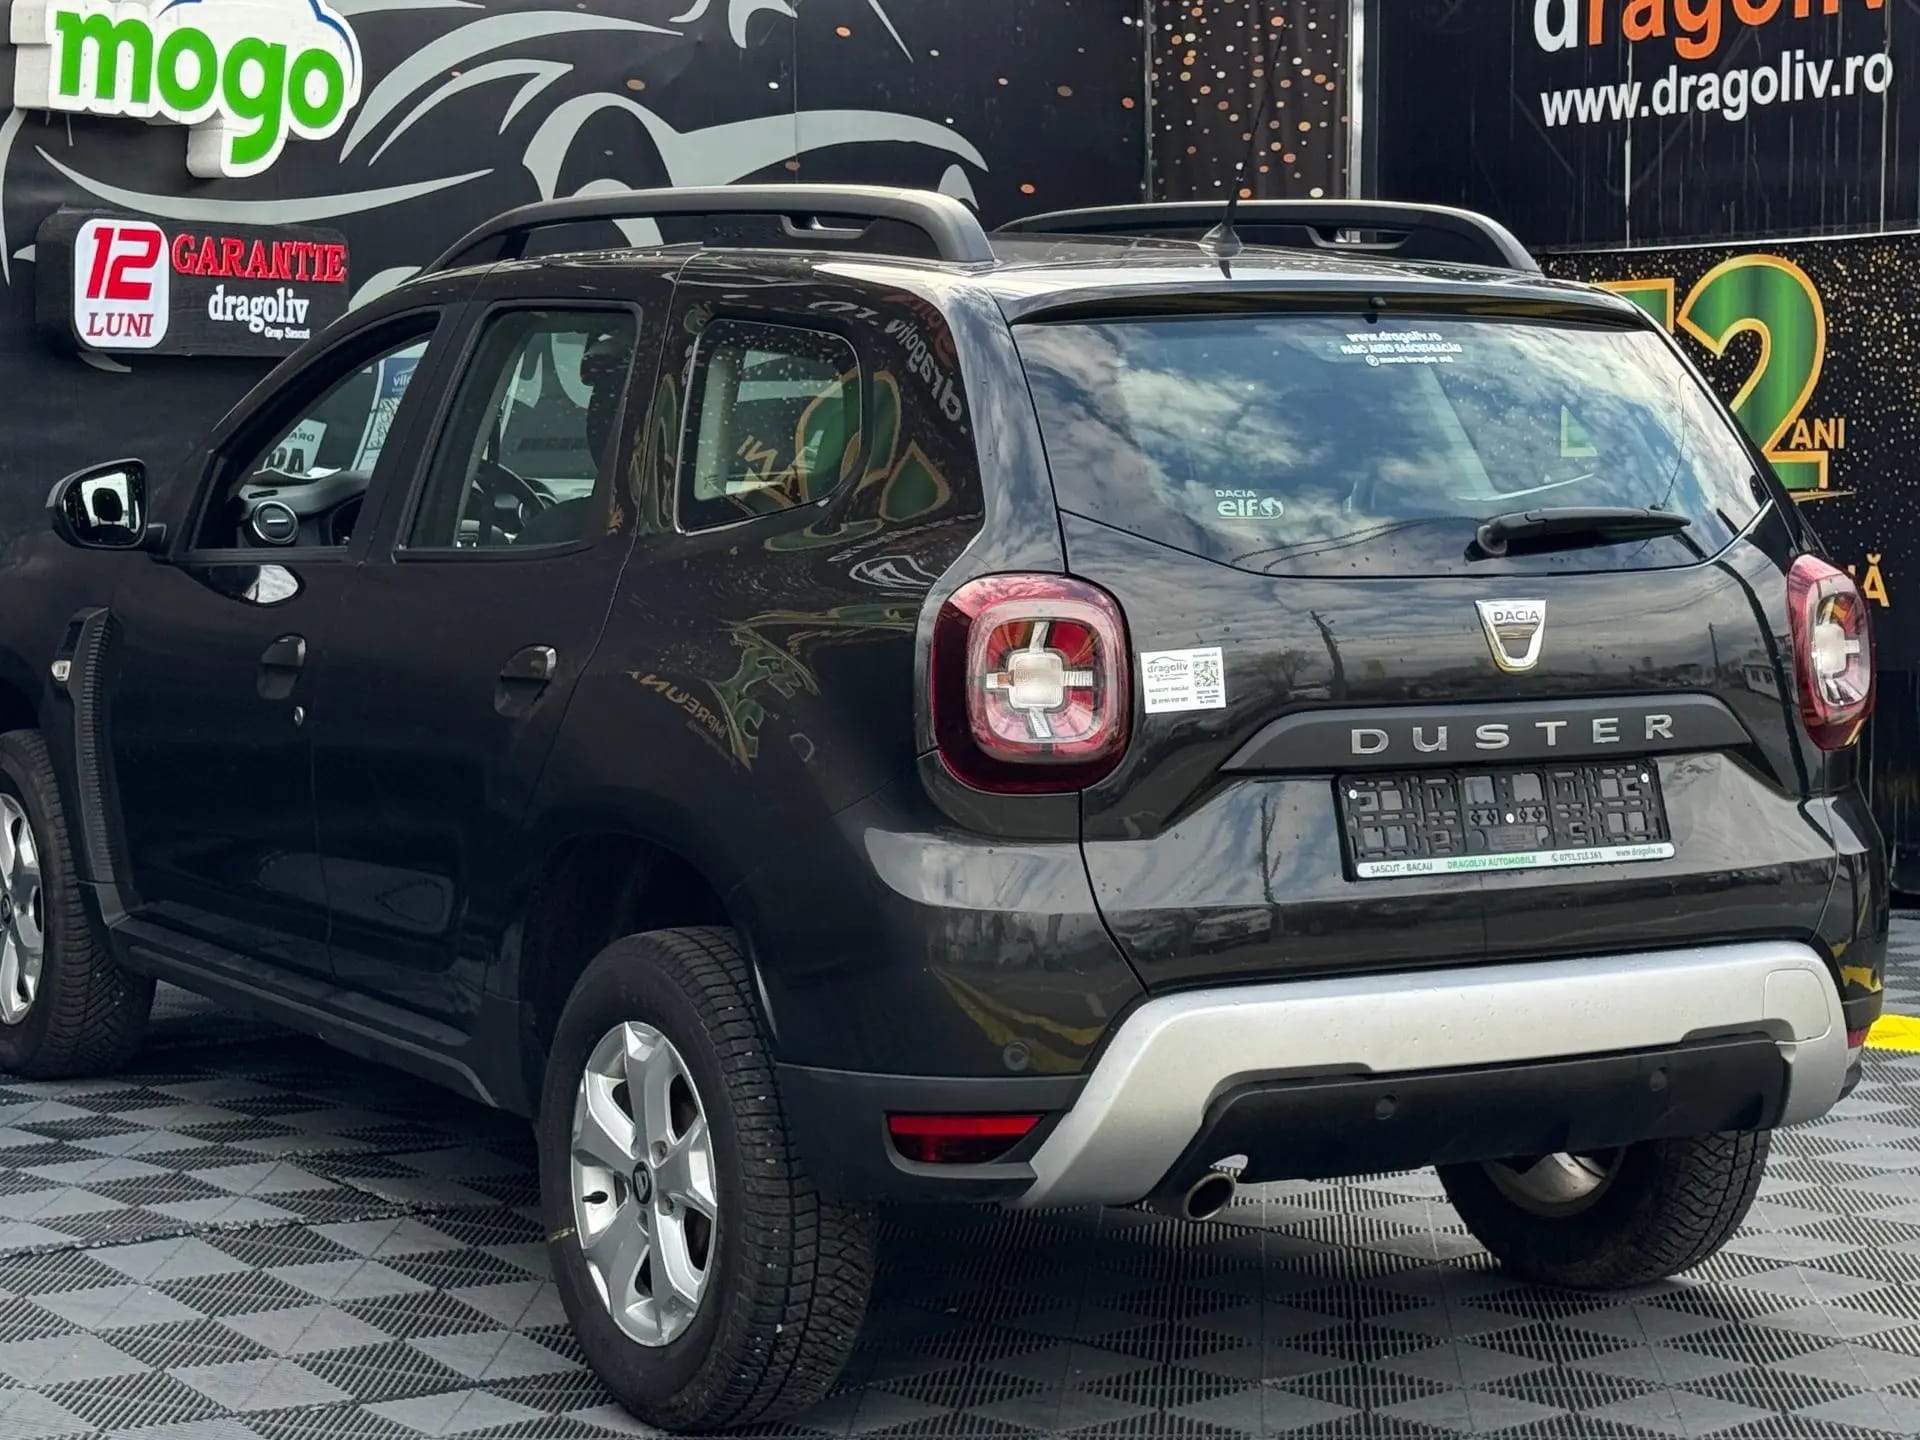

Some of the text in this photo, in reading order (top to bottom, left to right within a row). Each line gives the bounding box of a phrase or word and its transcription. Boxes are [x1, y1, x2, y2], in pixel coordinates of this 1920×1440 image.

[56, 10, 344, 164] mogo
[1541, 49, 1894, 127] www.dragoliv.ro
[86, 227, 161, 300] 12
[172, 233, 347, 282] GARANTIE
[86, 312, 154, 337] LUNI
[208, 284, 309, 333] dragoliv
[1790, 418, 1845, 450] ANI
[1215, 489, 1256, 497] DACIA
[1217, 499, 1257, 516] elf
[1494, 611, 1540, 621] DACIA
[1147, 662, 1188, 674] dragoliv
[1351, 714, 1674, 754] DUSTER
[1370, 864, 1400, 874] SASCUT
[1447, 859, 1487, 869] DRAGOLIV
[1488, 855, 1537, 866] AUTOMOBILE
